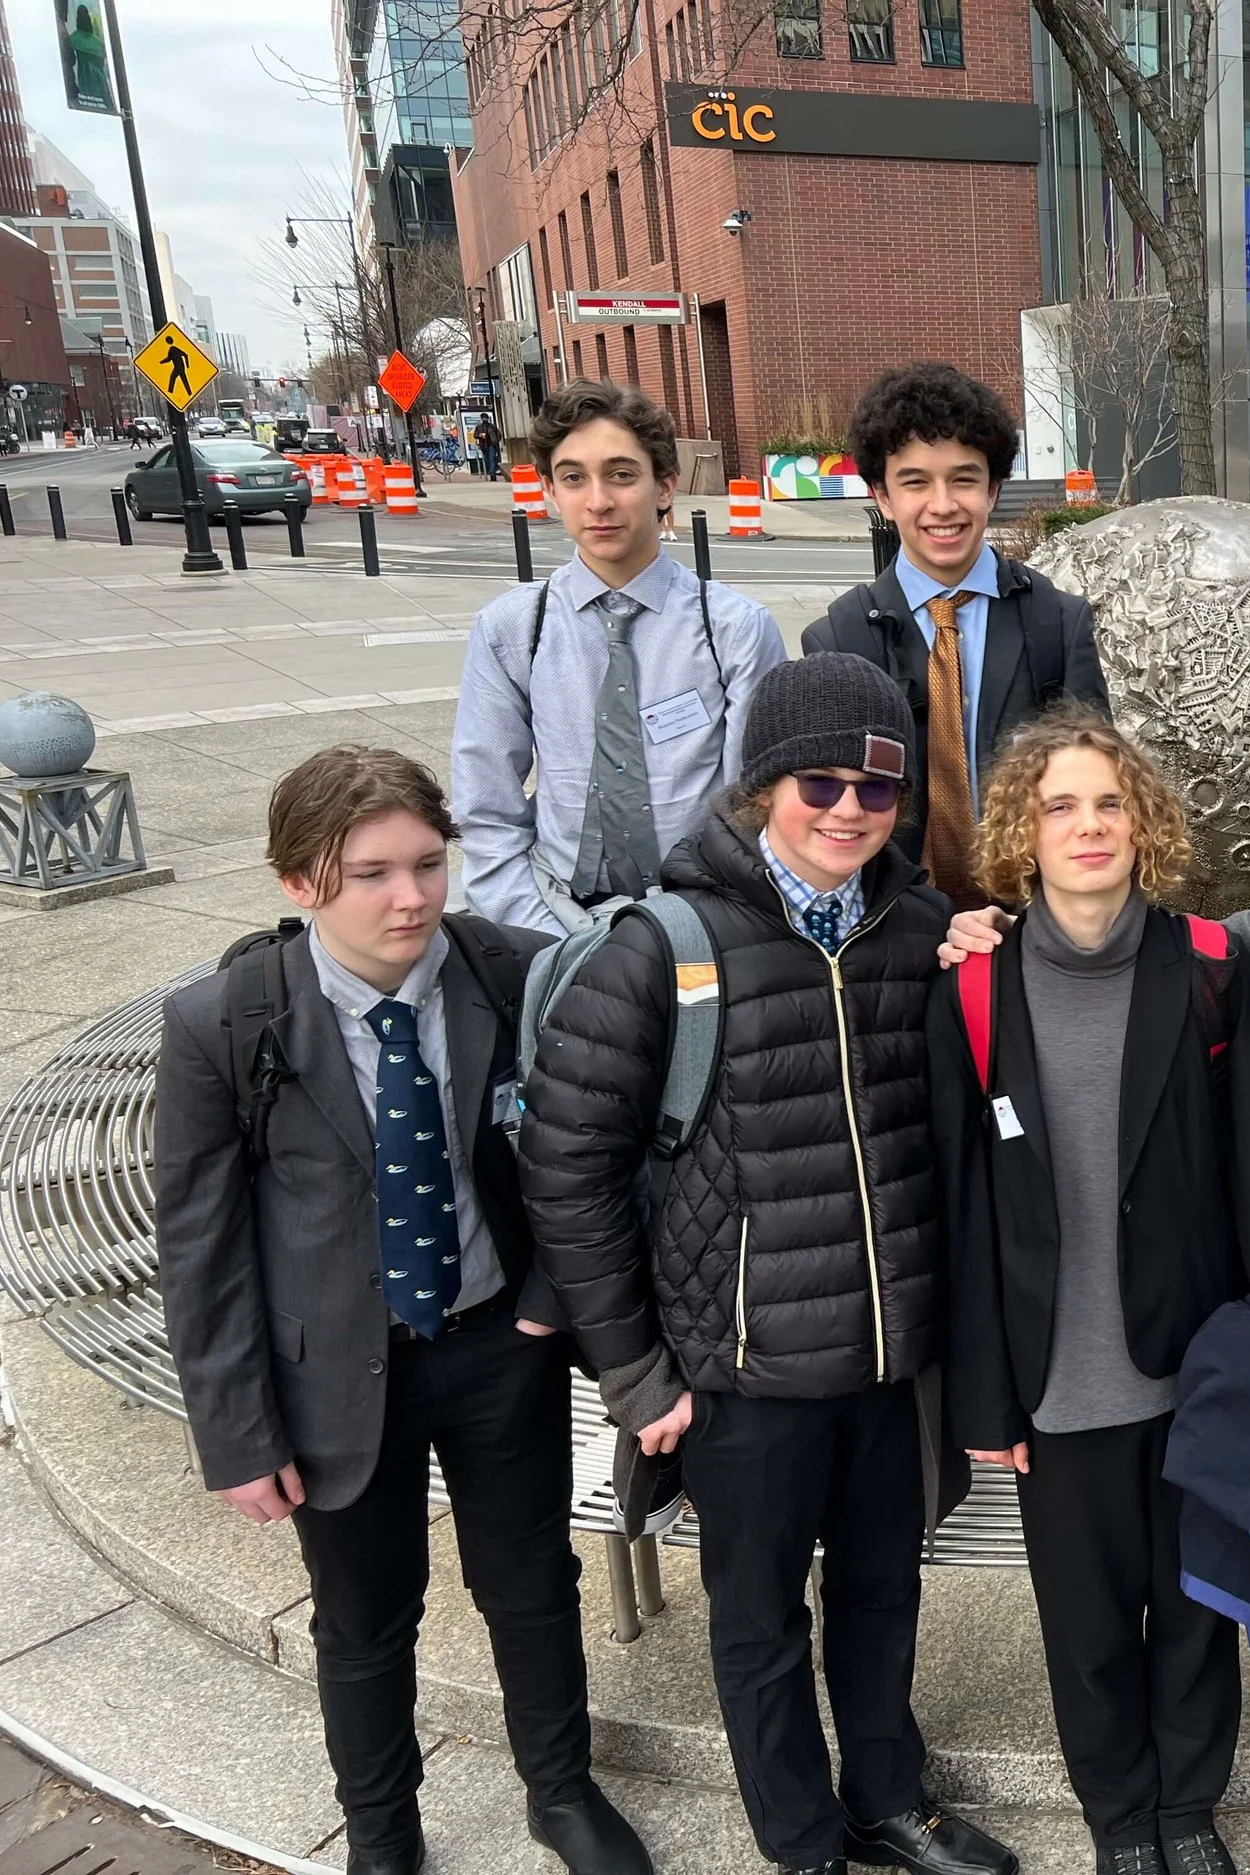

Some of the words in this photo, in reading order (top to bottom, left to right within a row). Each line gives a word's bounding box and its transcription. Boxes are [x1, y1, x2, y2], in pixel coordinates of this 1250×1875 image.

[612, 300, 646, 308] KENDALL
[392, 381, 412, 389] CLOSED
[395, 390, 413, 398] AHEAD
